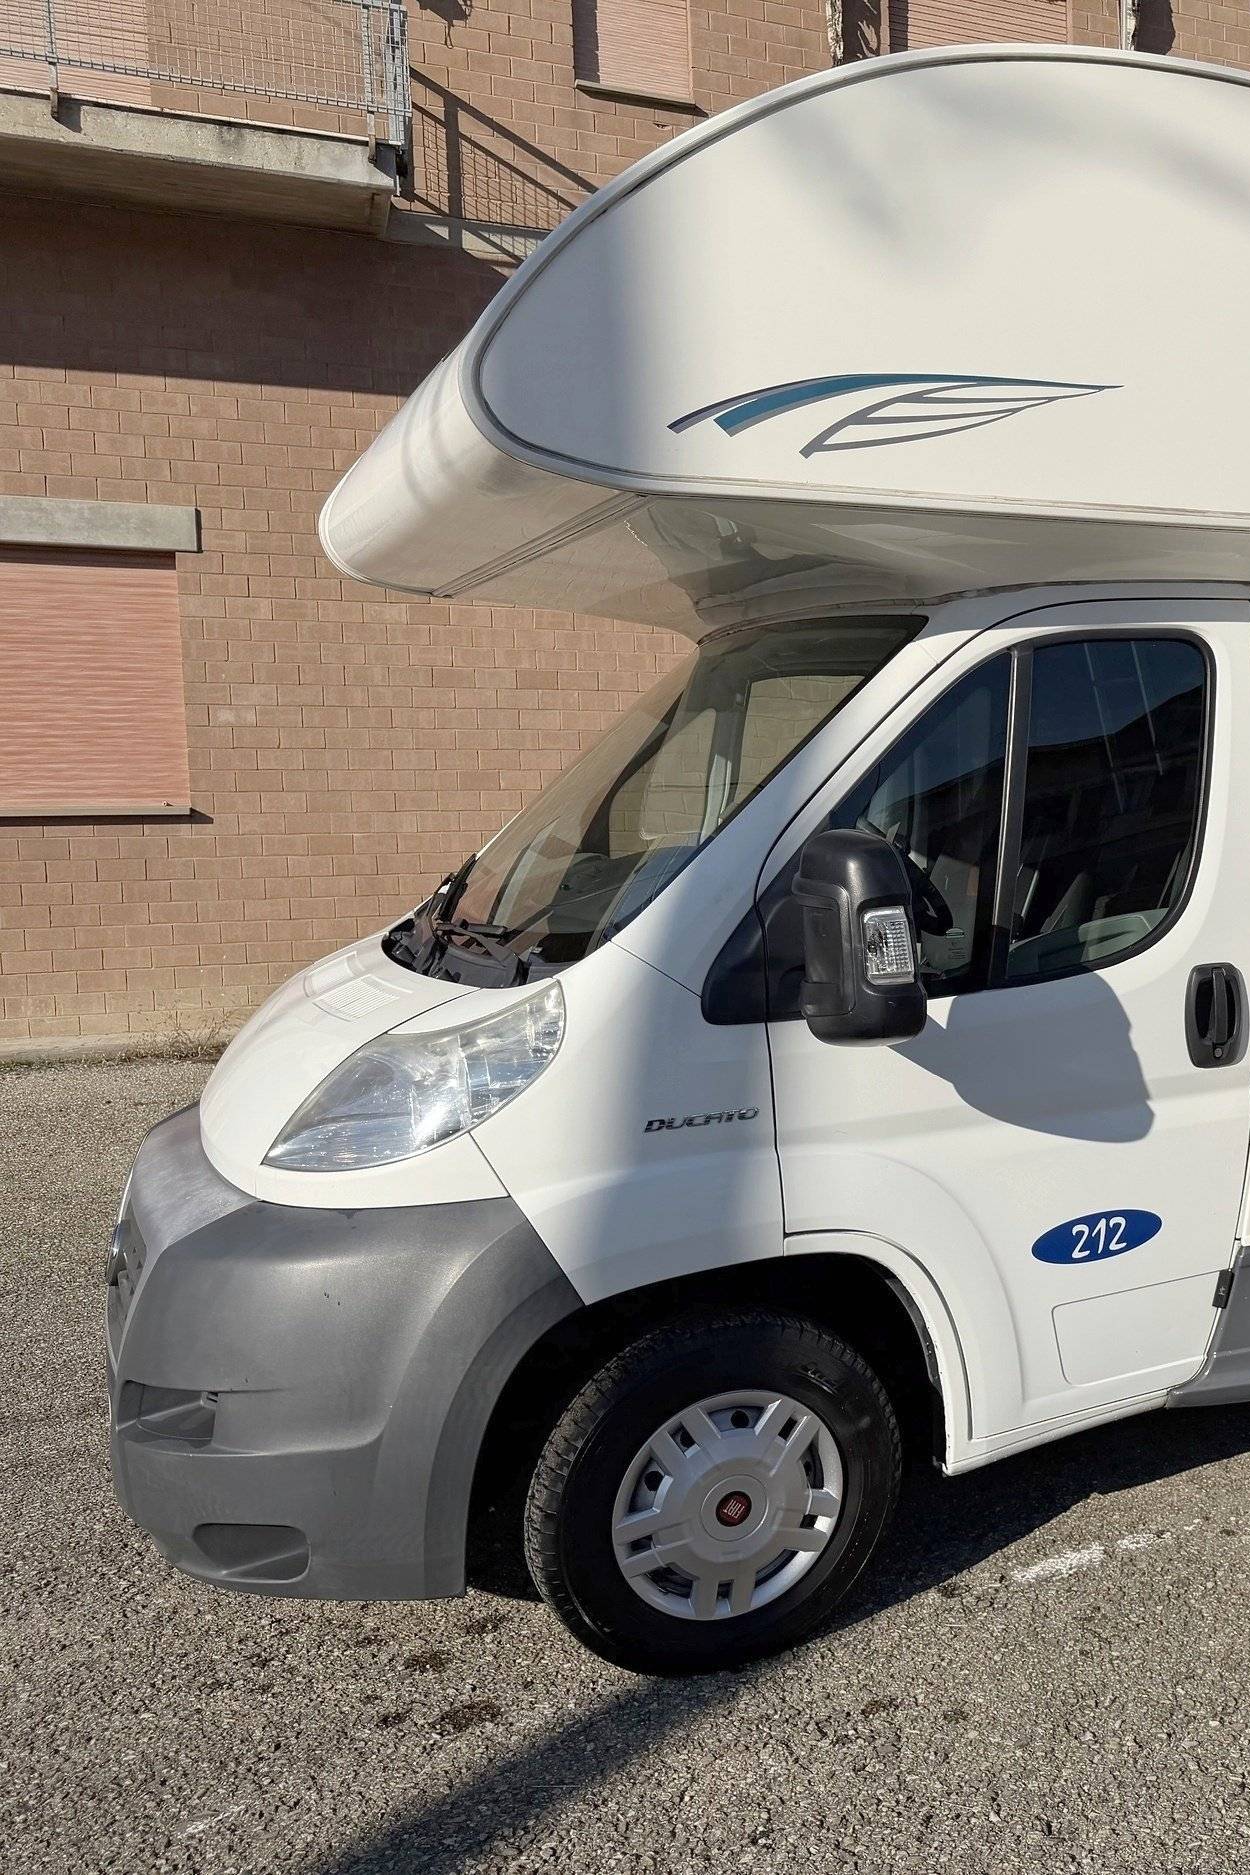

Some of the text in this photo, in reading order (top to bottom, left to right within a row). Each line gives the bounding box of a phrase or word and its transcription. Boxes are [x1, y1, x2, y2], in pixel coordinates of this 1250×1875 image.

[643, 1106, 760, 1132] DUCATO
[1071, 1216, 1127, 1259] 212
[722, 1499, 745, 1519] FIAT
